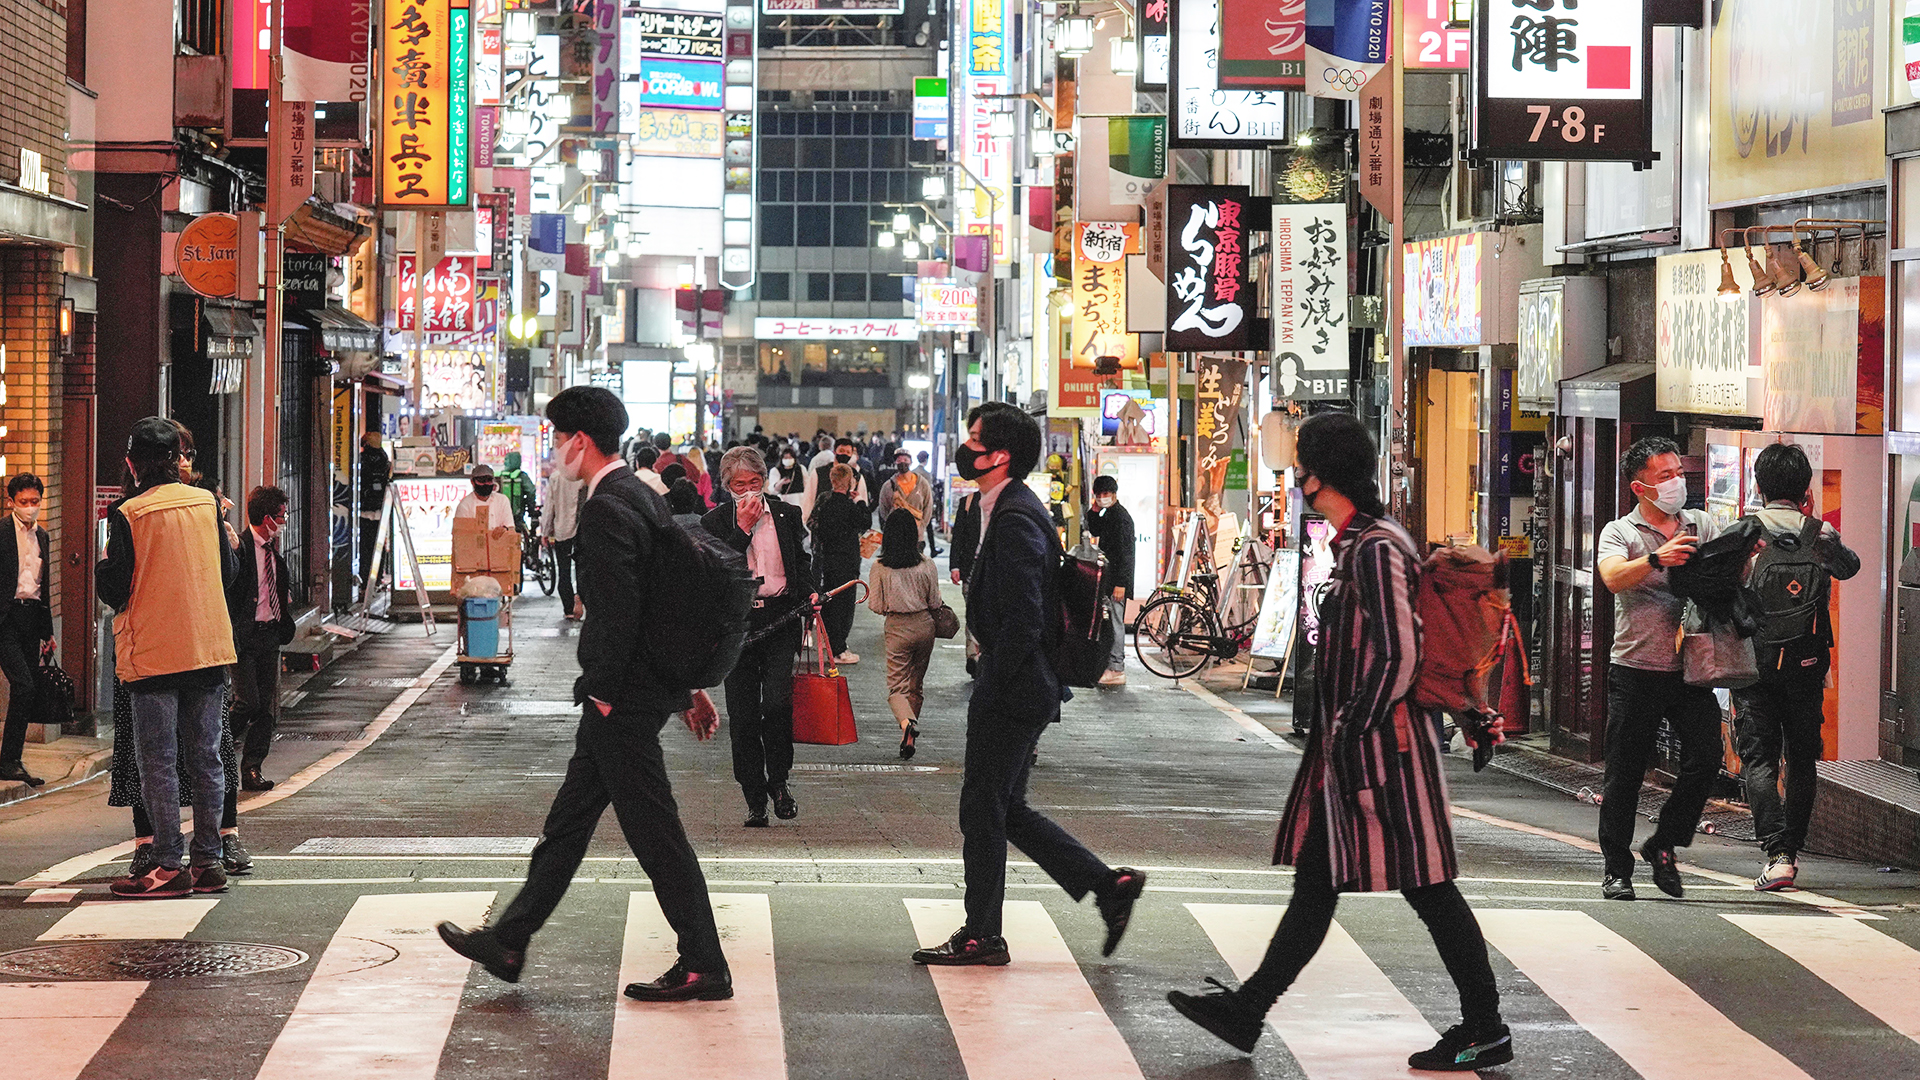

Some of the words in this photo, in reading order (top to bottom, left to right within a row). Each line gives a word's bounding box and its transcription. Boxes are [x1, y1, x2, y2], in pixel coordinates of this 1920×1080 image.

[1368, 28, 1383, 60] 2020
[1418, 30, 1468, 63] 2F
[350, 51, 368, 102] 2020
[1184, 86, 1201, 137] 一番街
[480, 113, 490, 143] TOKYO
[1154, 123, 1163, 153] TOKYO
[1247, 120, 1282, 137] B1F
[1368, 96, 1383, 186] 劇場通り一番街
[479, 142, 490, 165] 2020
[1154, 154, 1163, 176] 2020
[1084, 230, 1123, 252] 新宿
[1213, 198, 1242, 302] 東京豚骨
[1278, 217, 1292, 273] HIROSHIMA
[1096, 250, 1111, 260] の
[1299, 215, 1345, 355] お好み焼き
[1080, 265, 1111, 357] まっちゃん
[773, 321, 823, 336] コーヒー
[862, 322, 899, 337] クール
[1063, 382, 1095, 393] ONLINE
[1312, 378, 1348, 395] B1F
[1502, 388, 1510, 411] 5F
[1085, 395, 1096, 405] B1
[336, 405, 344, 425] Tuna
[334, 425, 344, 472] Restaurant
[1501, 453, 1509, 475] 4F
